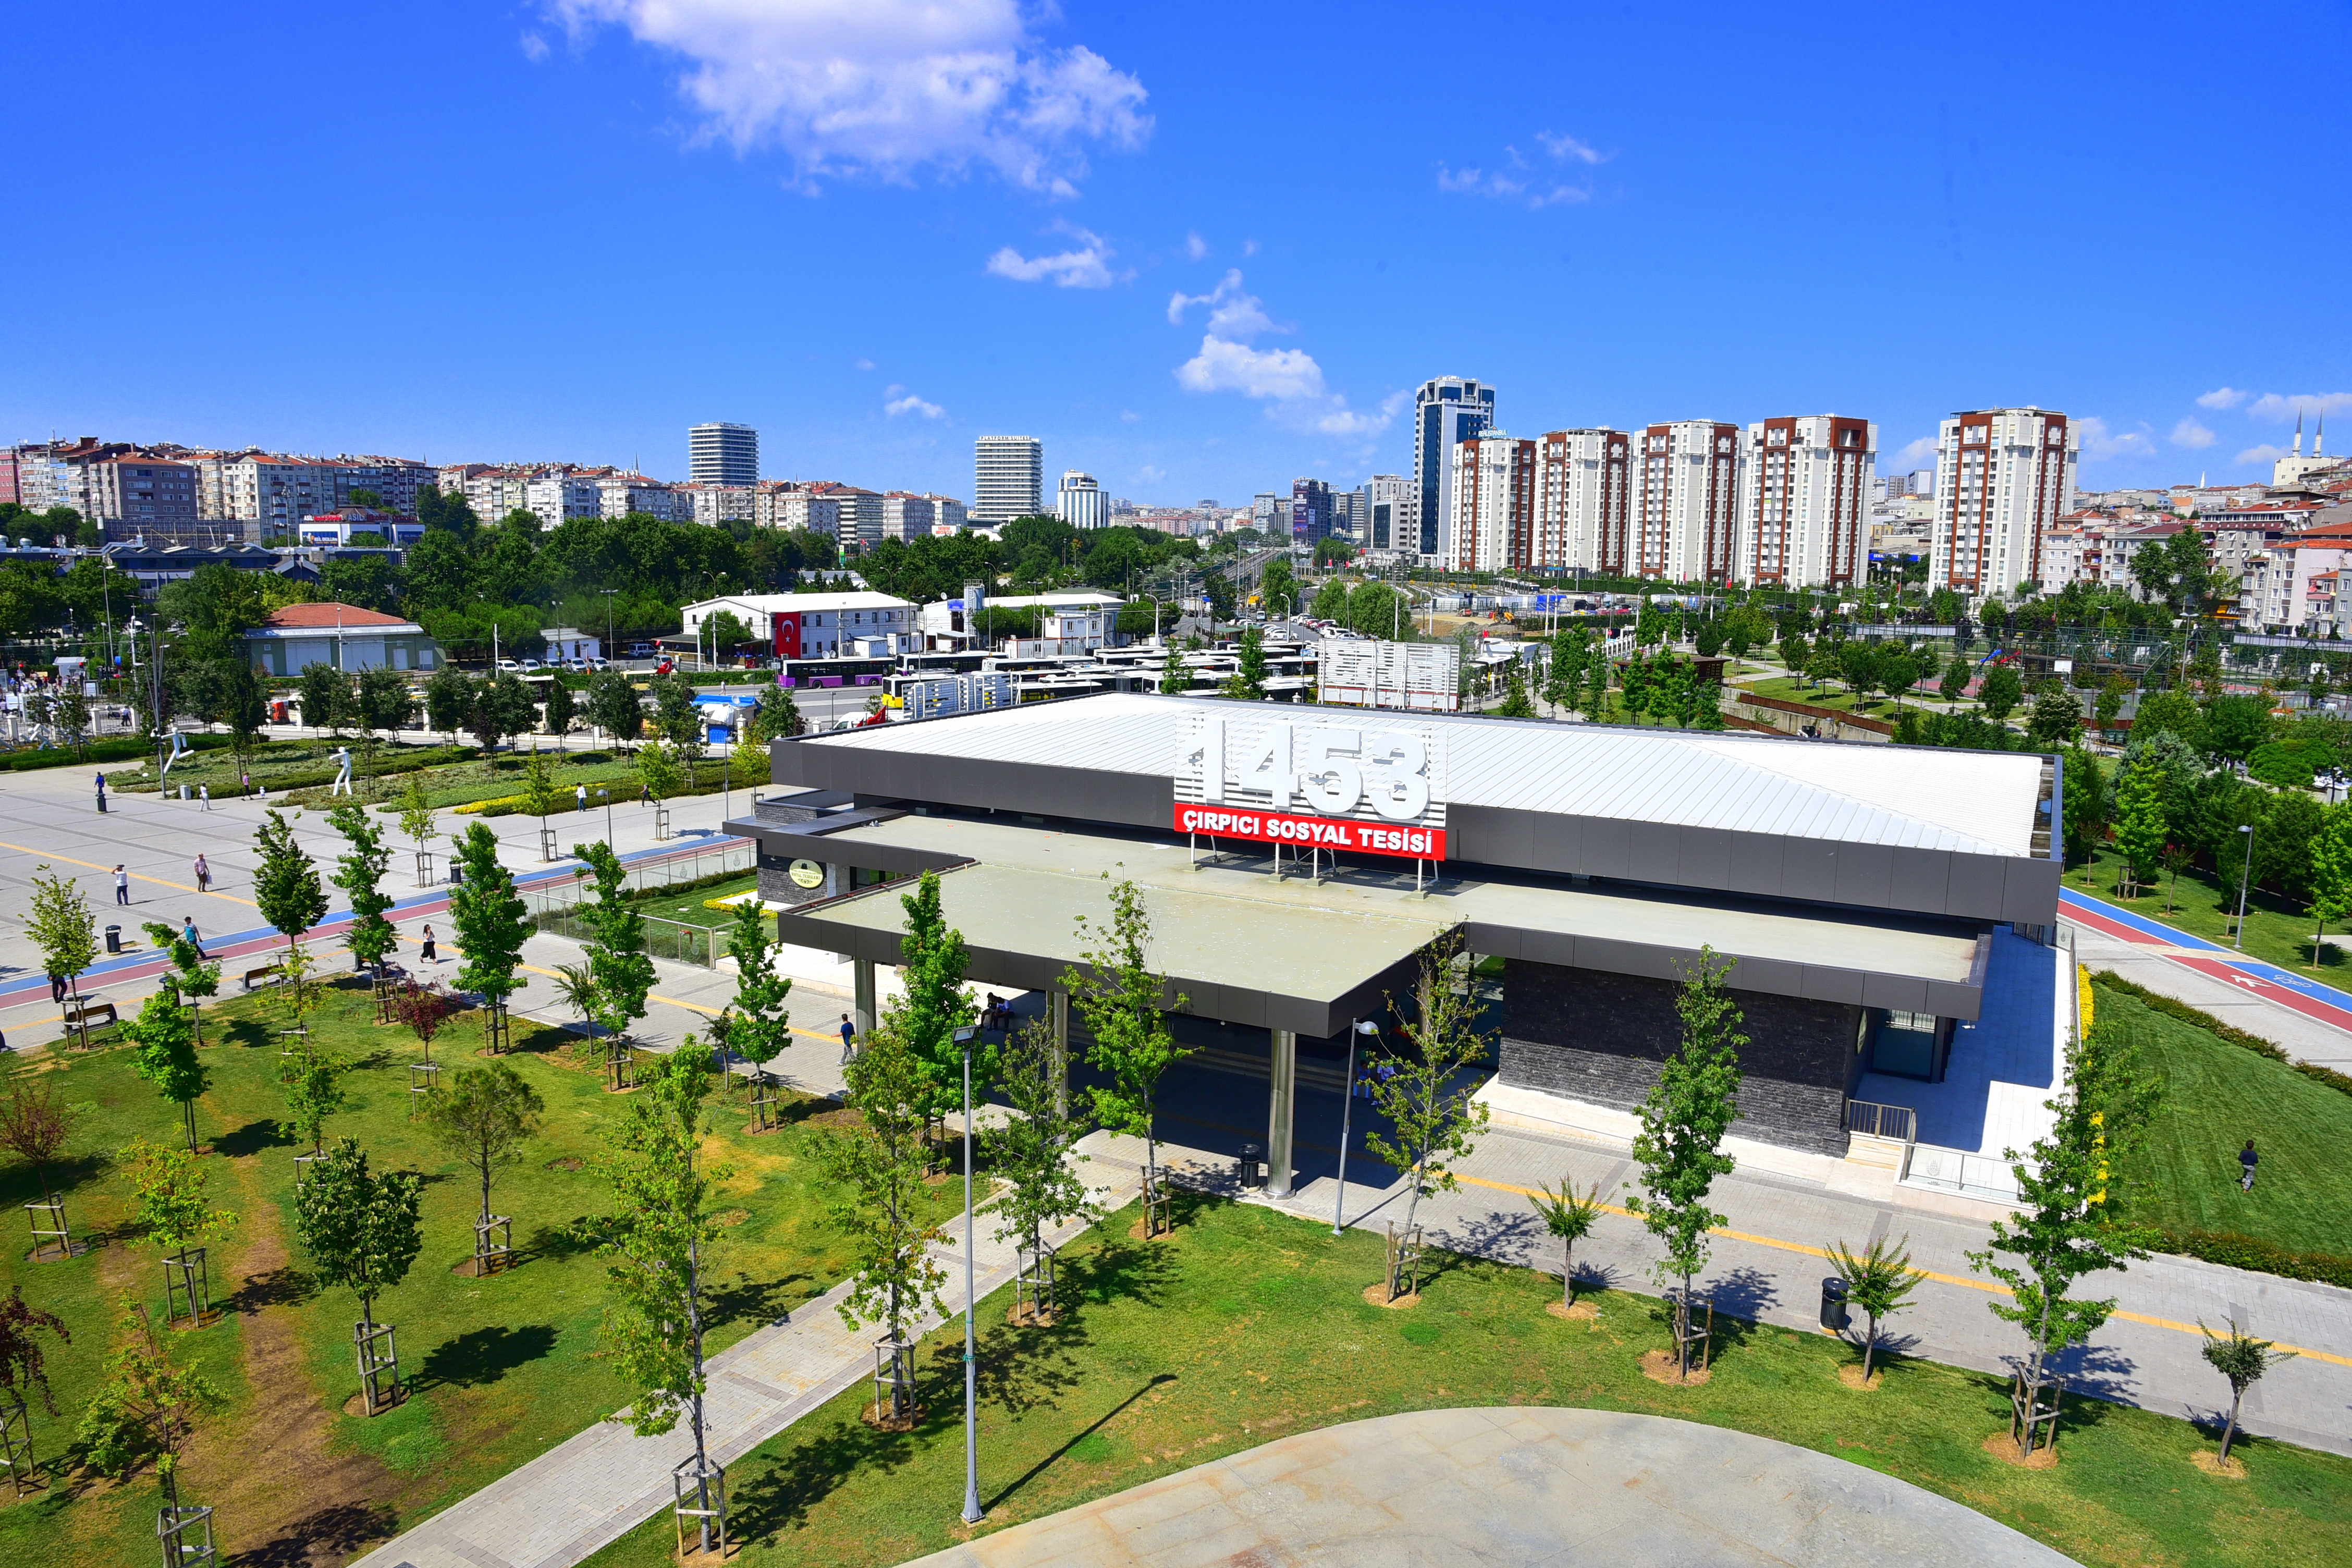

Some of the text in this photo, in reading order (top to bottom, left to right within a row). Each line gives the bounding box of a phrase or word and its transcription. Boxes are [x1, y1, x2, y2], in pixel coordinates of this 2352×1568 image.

[1184, 717, 1430, 820] 1453
[1183, 810, 1432, 854] ÇIRPICI SOSYAL TESİSİ
